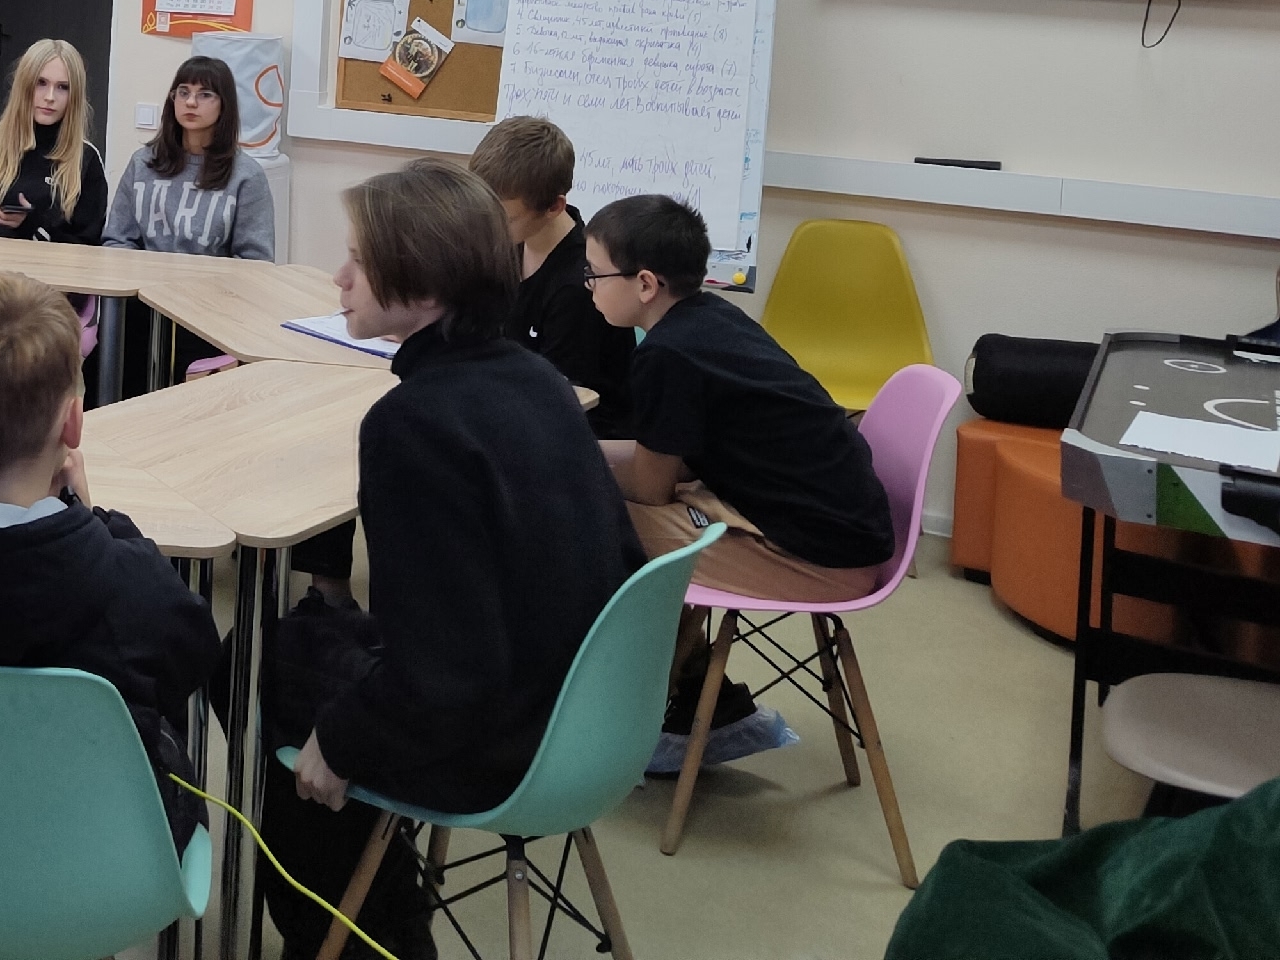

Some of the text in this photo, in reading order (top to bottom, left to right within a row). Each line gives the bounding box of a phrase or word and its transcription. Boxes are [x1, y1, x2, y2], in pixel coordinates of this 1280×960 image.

[713, 24, 728, 44] (8)
[720, 58, 737, 82] (7)
[562, 92, 572, 107] и
